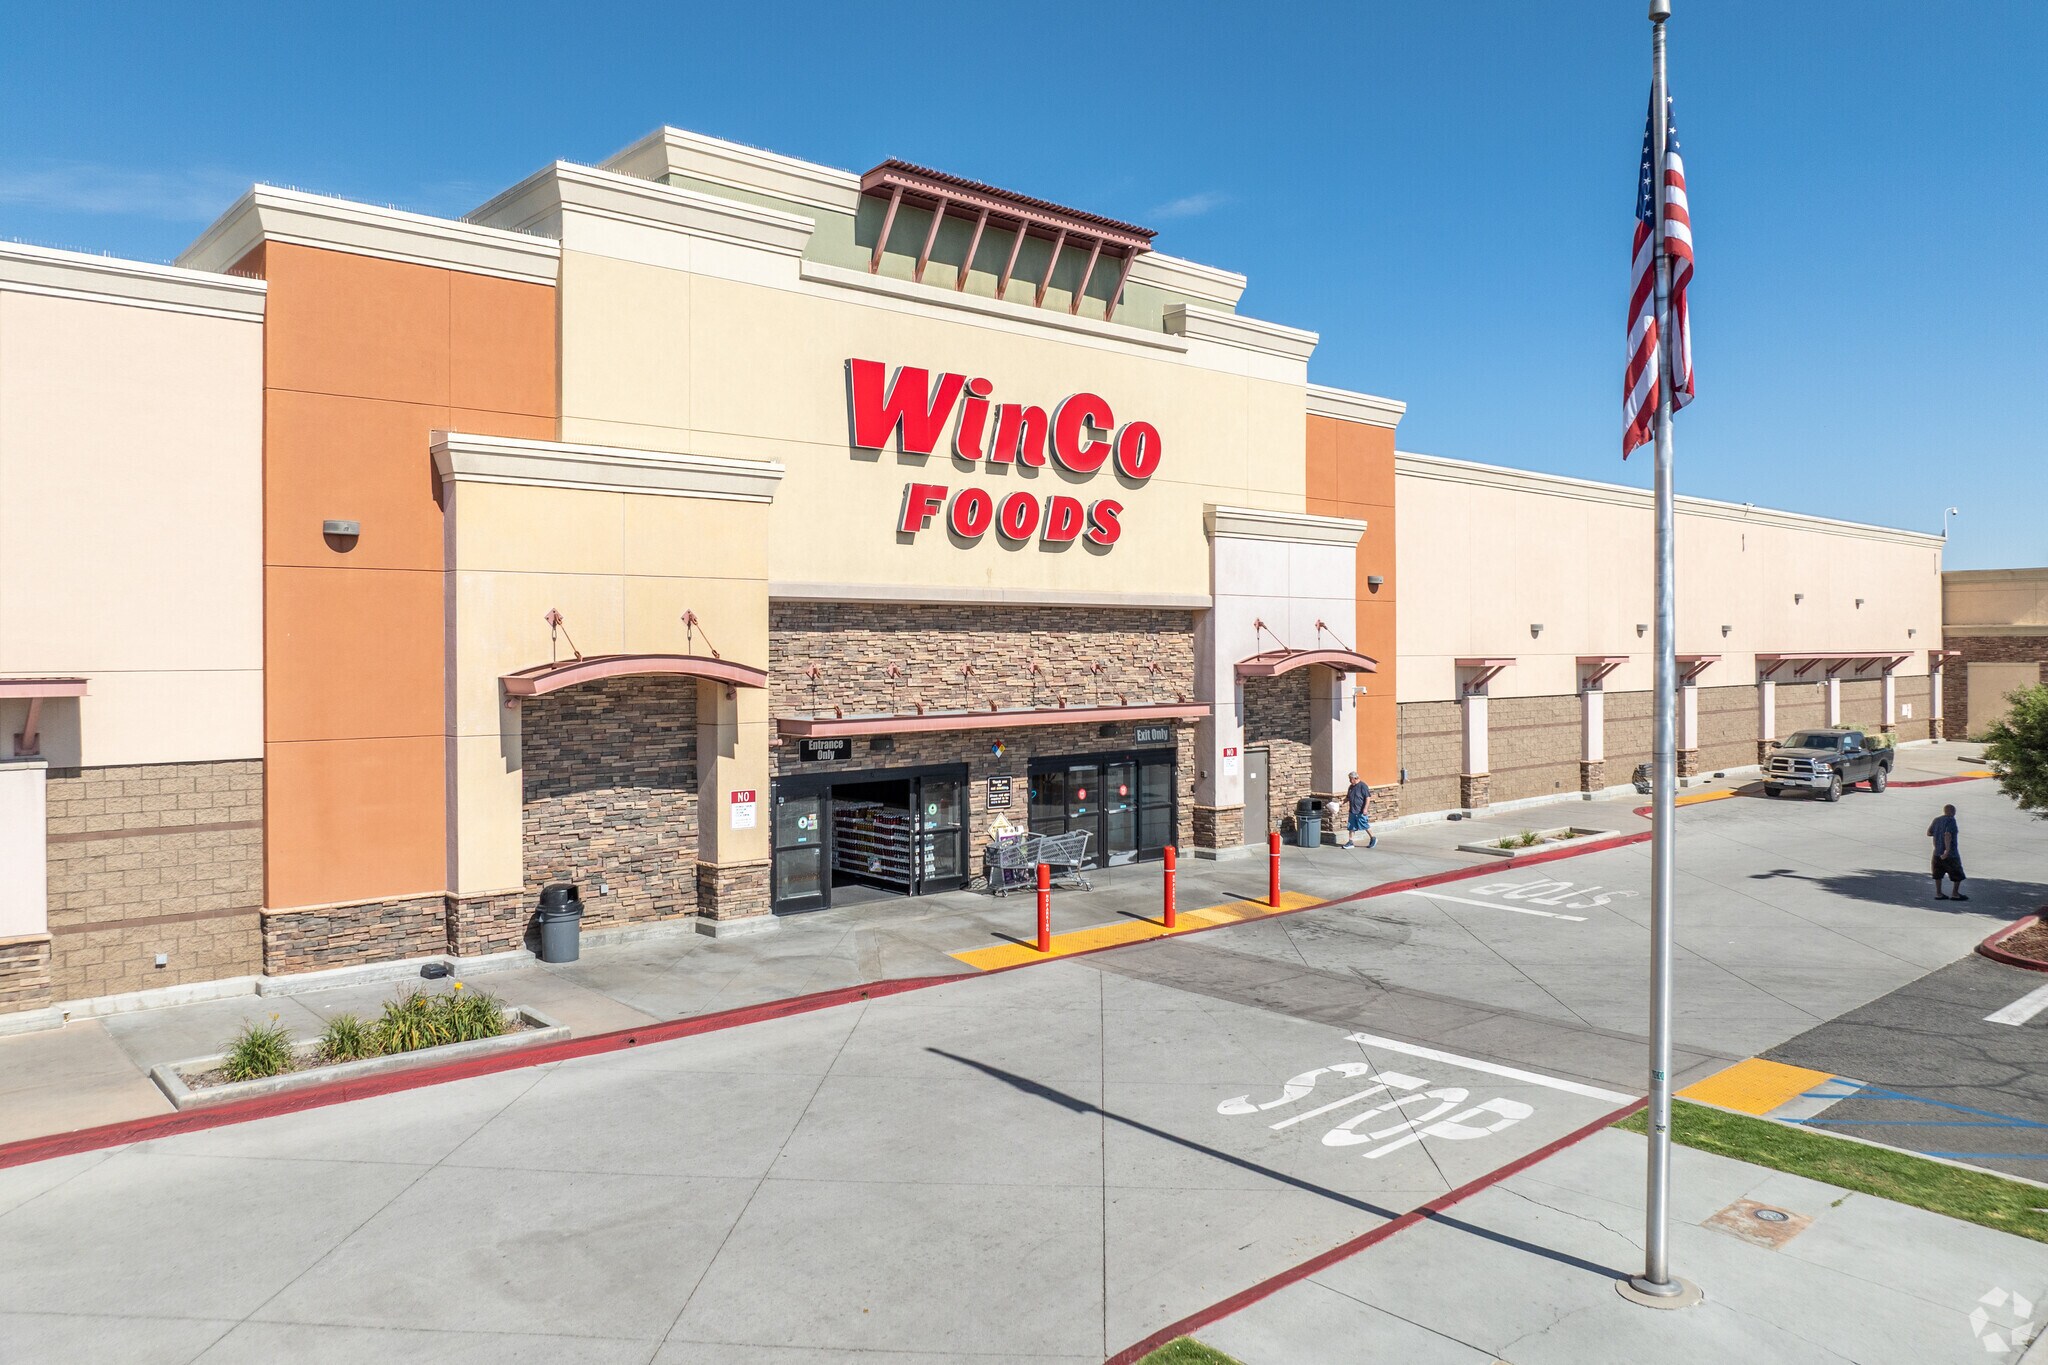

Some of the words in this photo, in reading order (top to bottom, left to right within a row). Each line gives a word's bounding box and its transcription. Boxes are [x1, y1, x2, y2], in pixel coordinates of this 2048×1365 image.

[846, 358, 1162, 480] WinCo
[898, 483, 1124, 546] FOODS
[1136, 729, 1151, 741] Exit
[1151, 728, 1168, 740] Only
[808, 740, 844, 750] Entrance
[817, 750, 835, 760] Only
[1226, 748, 1234, 757] NO
[737, 791, 750, 802] NO
[1469, 878, 1639, 909] STOP
[1217, 1062, 1535, 1159] STOP
